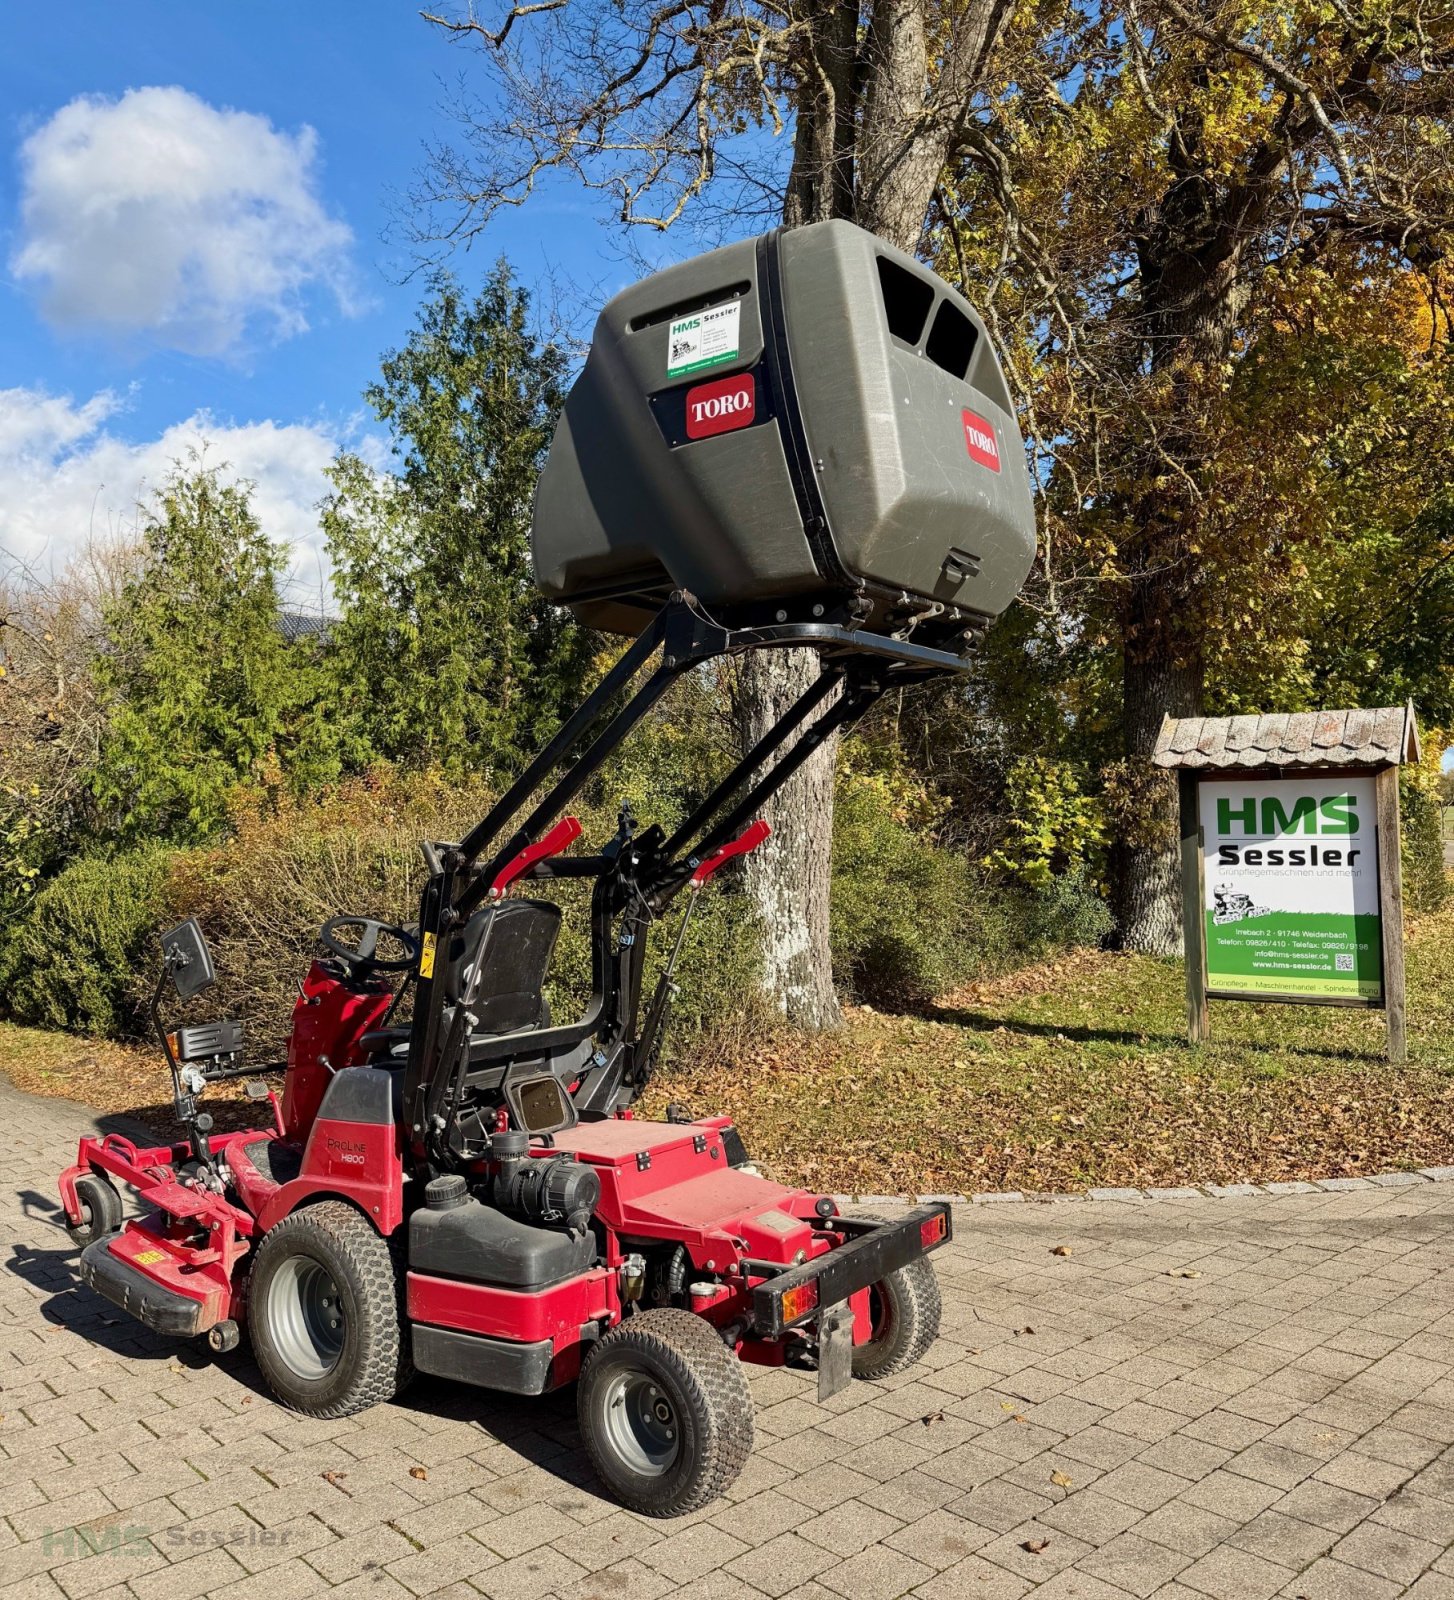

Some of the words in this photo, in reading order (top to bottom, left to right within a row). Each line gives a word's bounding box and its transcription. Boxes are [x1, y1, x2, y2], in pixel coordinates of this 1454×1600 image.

[673, 318, 701, 335] HMS
[704, 307, 738, 322] Sessler
[1217, 796, 1360, 835] HMS
[1218, 845, 1361, 866] Sessler
[1219, 868, 1313, 877] Grünpflegemaschinen
[1316, 868, 1333, 877] und
[1254, 950, 1329, 959] info@hms-sessler.de
[1252, 961, 1332, 970] www.hms-sessler.de
[1255, 981, 1316, 991] Maschinenhandel
